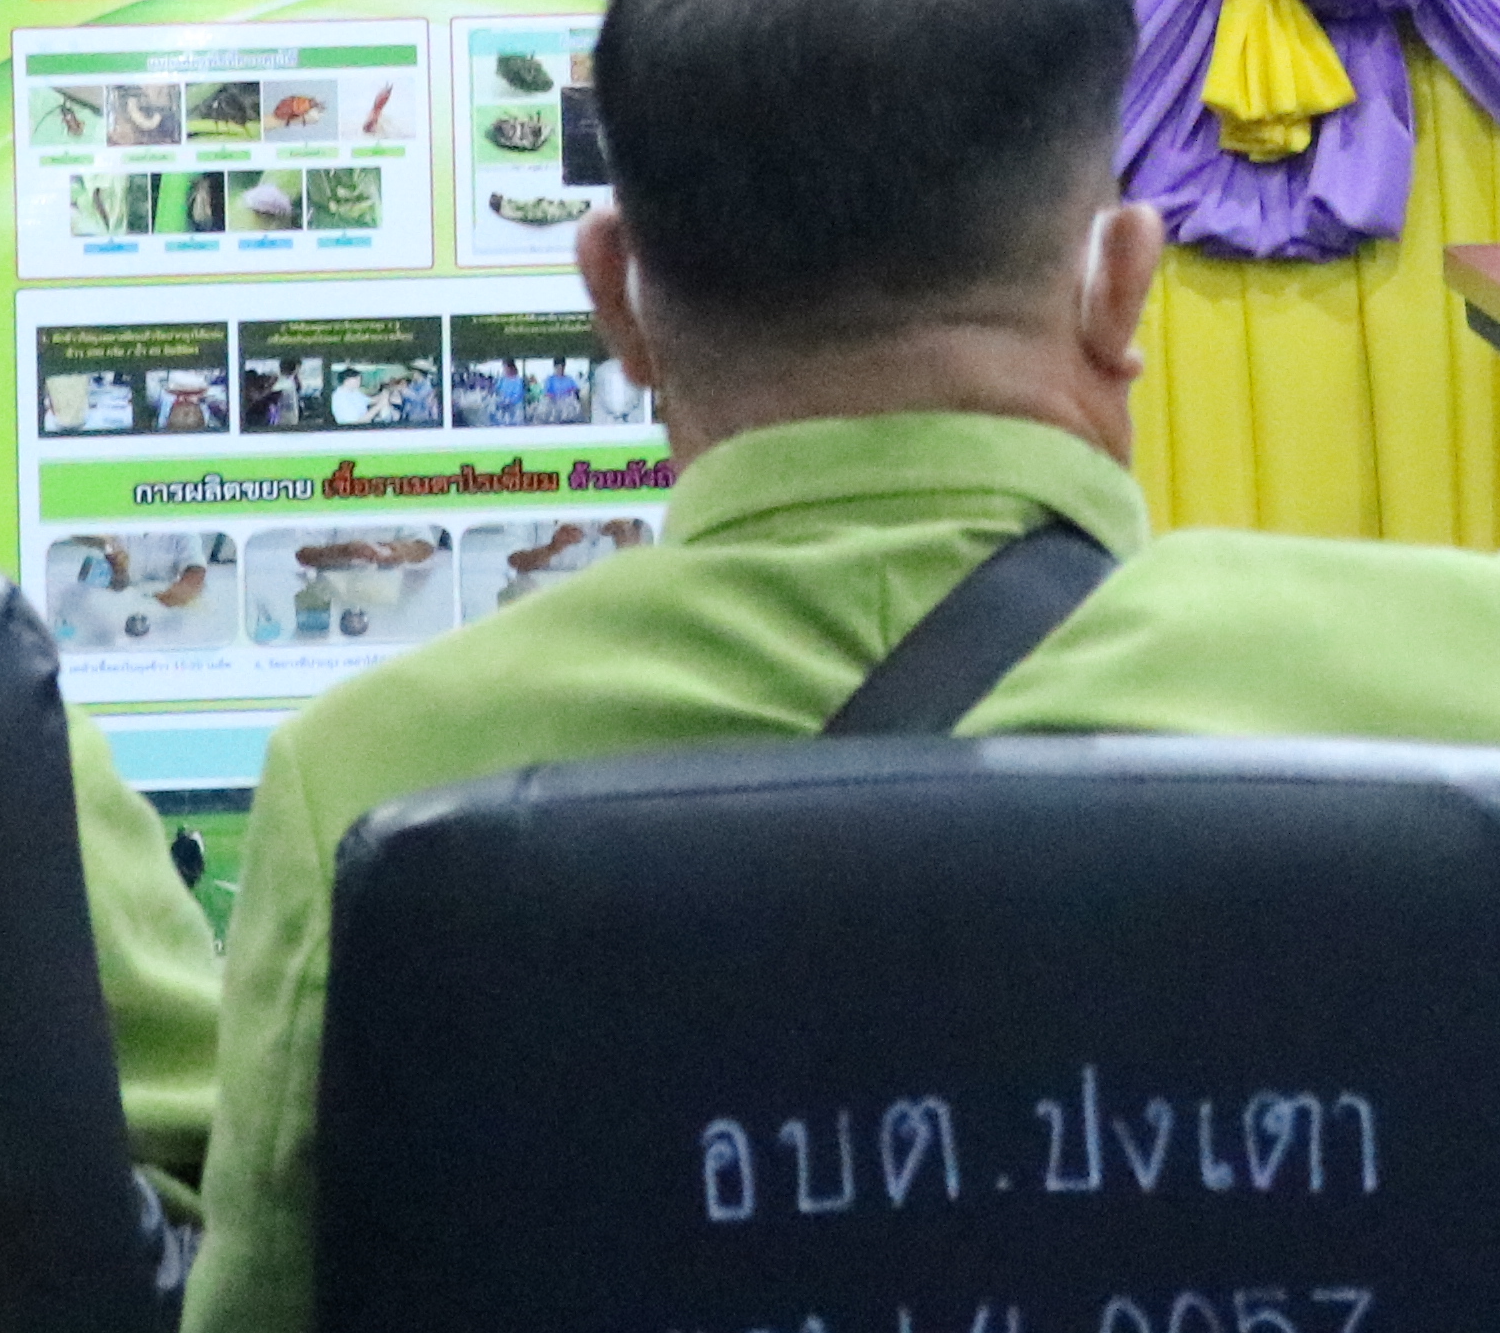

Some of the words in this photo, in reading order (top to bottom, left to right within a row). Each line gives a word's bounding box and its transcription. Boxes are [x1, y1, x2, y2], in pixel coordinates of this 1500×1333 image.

[134, 472, 314, 504] การผลิตขยาย
[702, 1063, 1378, 1221] อบต.ปงเตา
